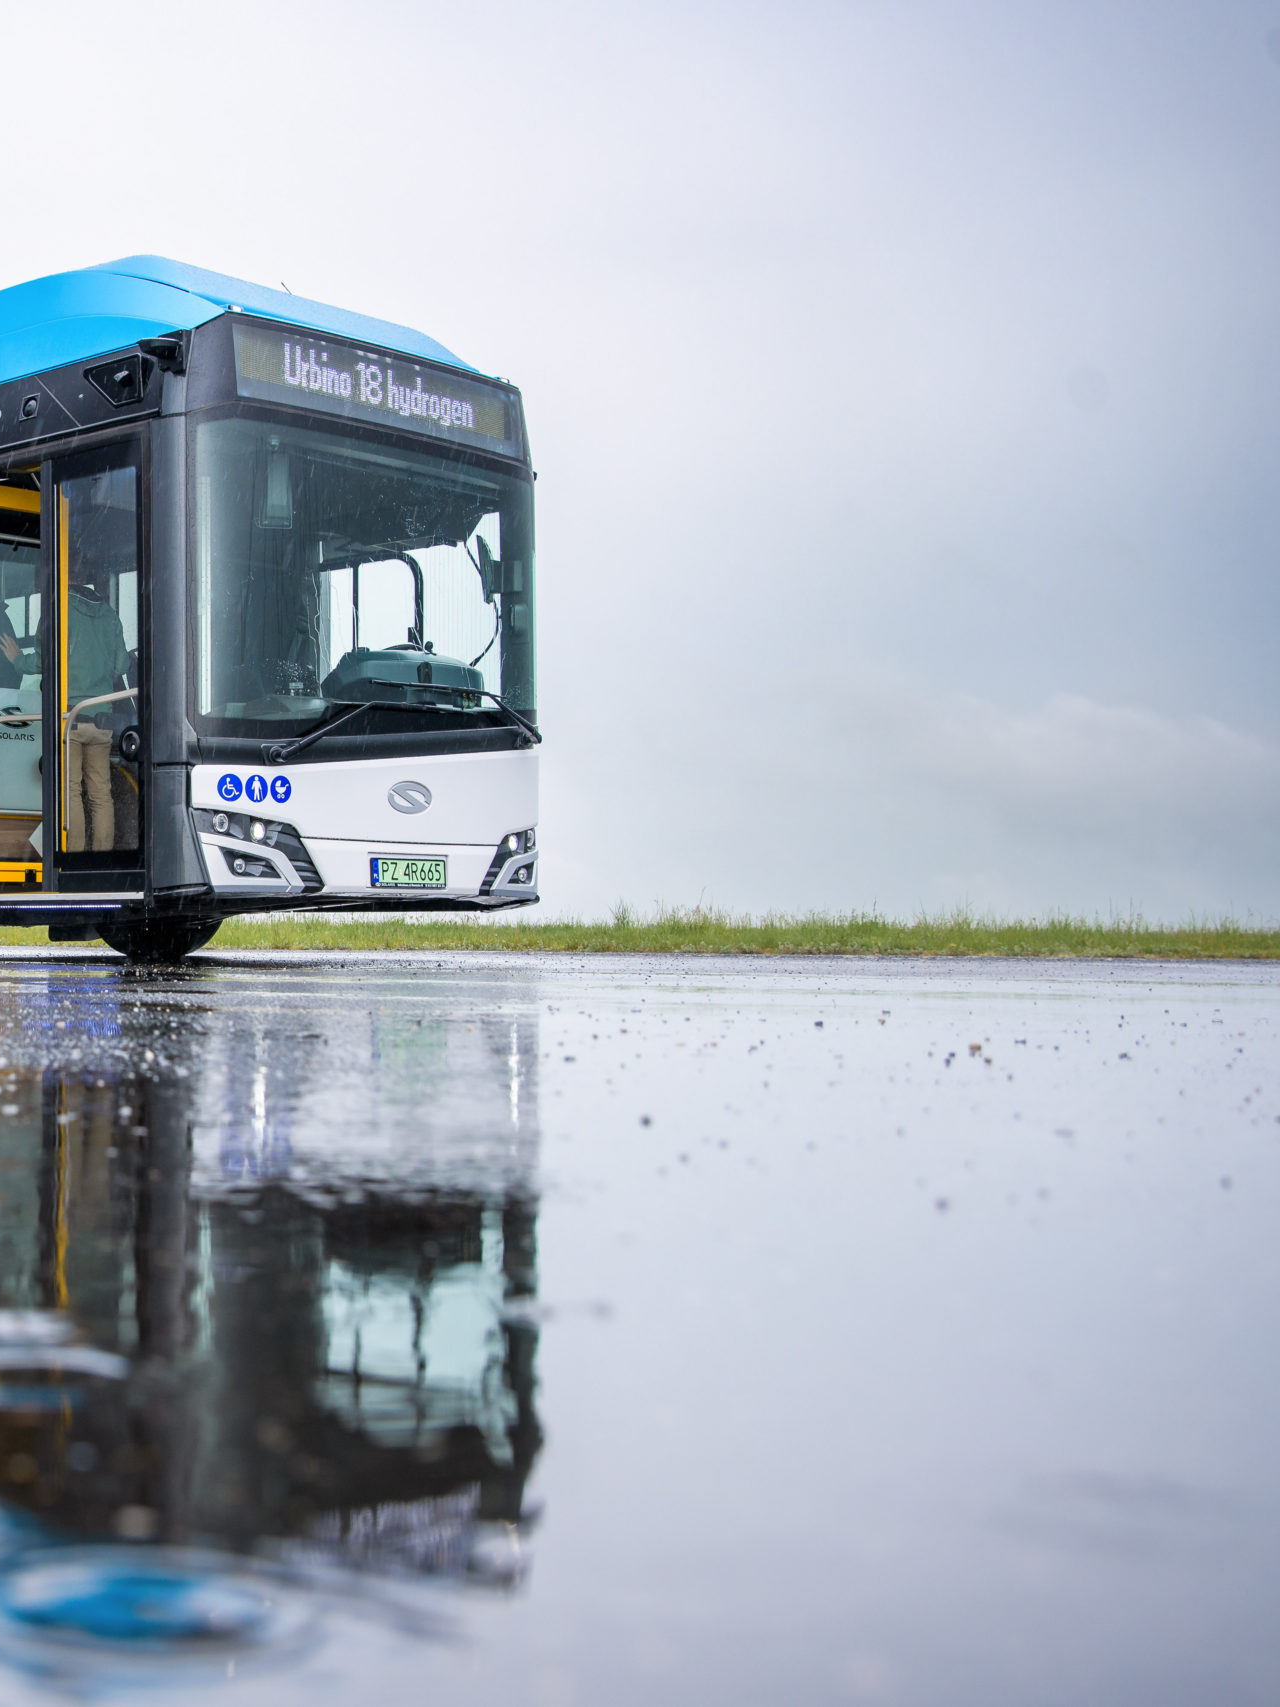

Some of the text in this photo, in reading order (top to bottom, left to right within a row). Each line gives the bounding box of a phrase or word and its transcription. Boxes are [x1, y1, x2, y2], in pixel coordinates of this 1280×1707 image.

[282, 342, 474, 428] Urbino 18 hydrogen
[381, 861, 442, 882] PZ 4R665
